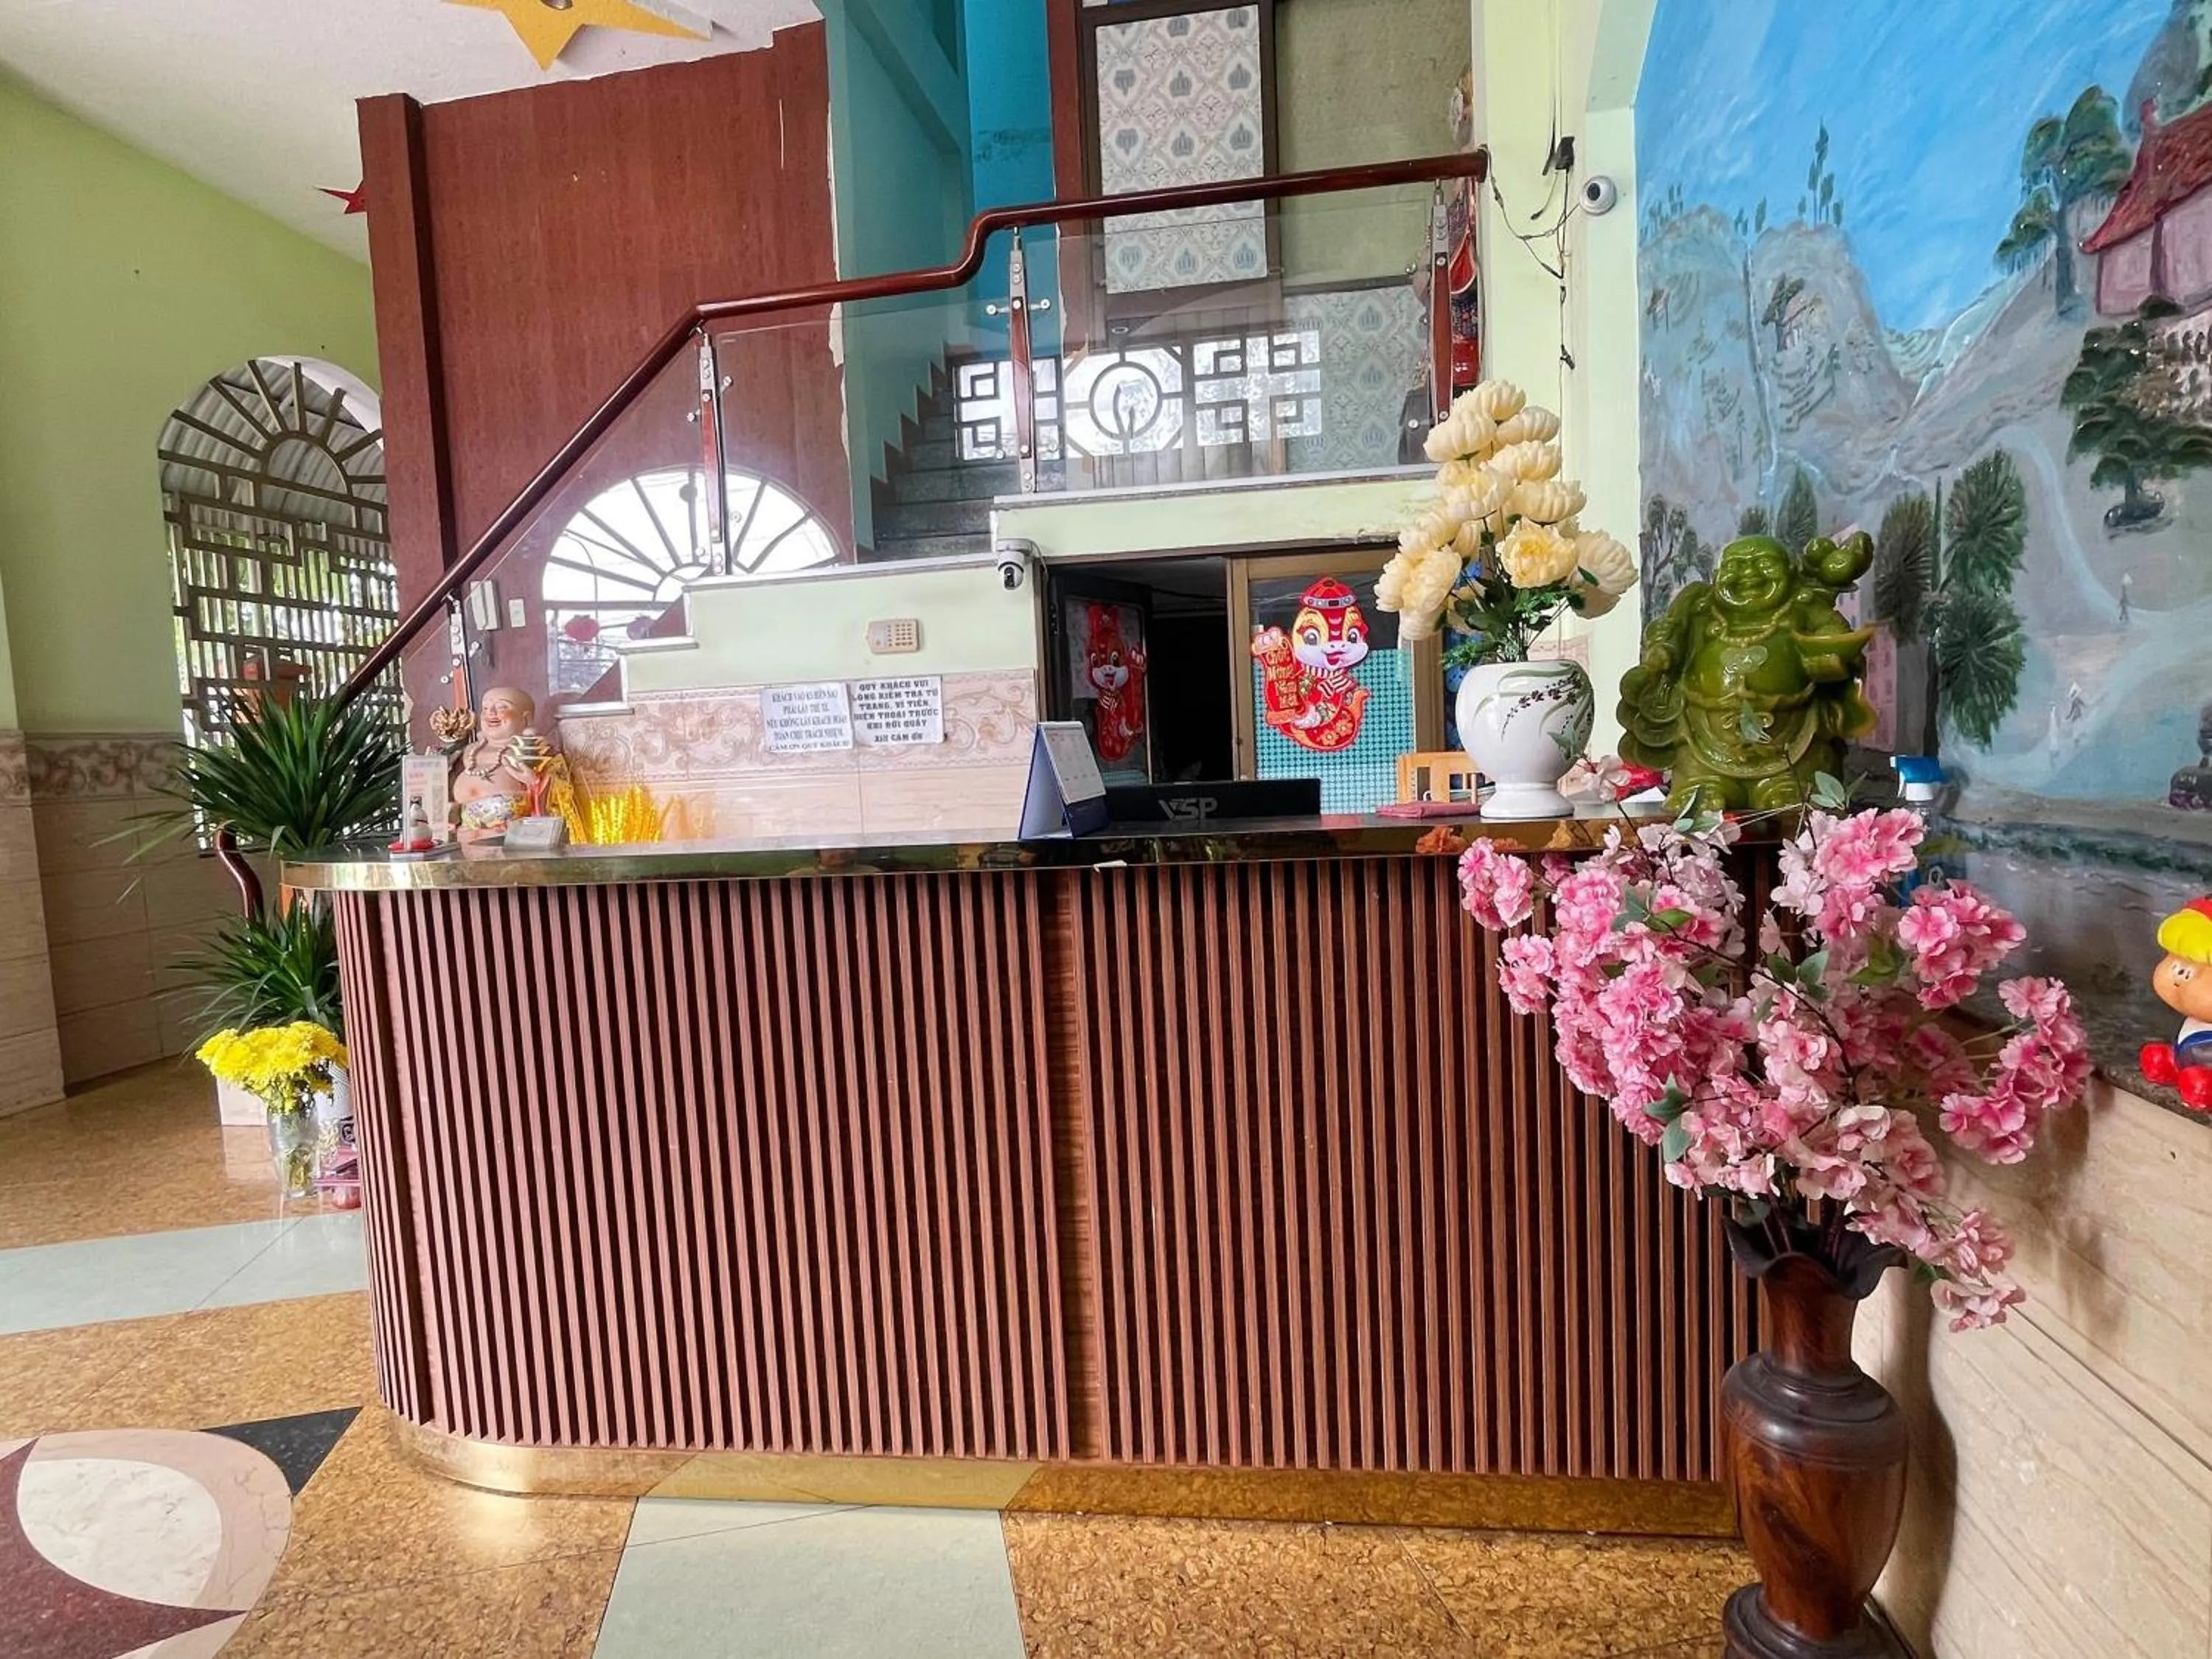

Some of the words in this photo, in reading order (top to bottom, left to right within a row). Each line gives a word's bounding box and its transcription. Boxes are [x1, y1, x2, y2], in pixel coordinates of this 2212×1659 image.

[914, 679, 929, 688] VUI
[866, 722, 883, 730] KHI
[874, 734, 888, 742] XIN
[1158, 797, 1218, 821] VSP
